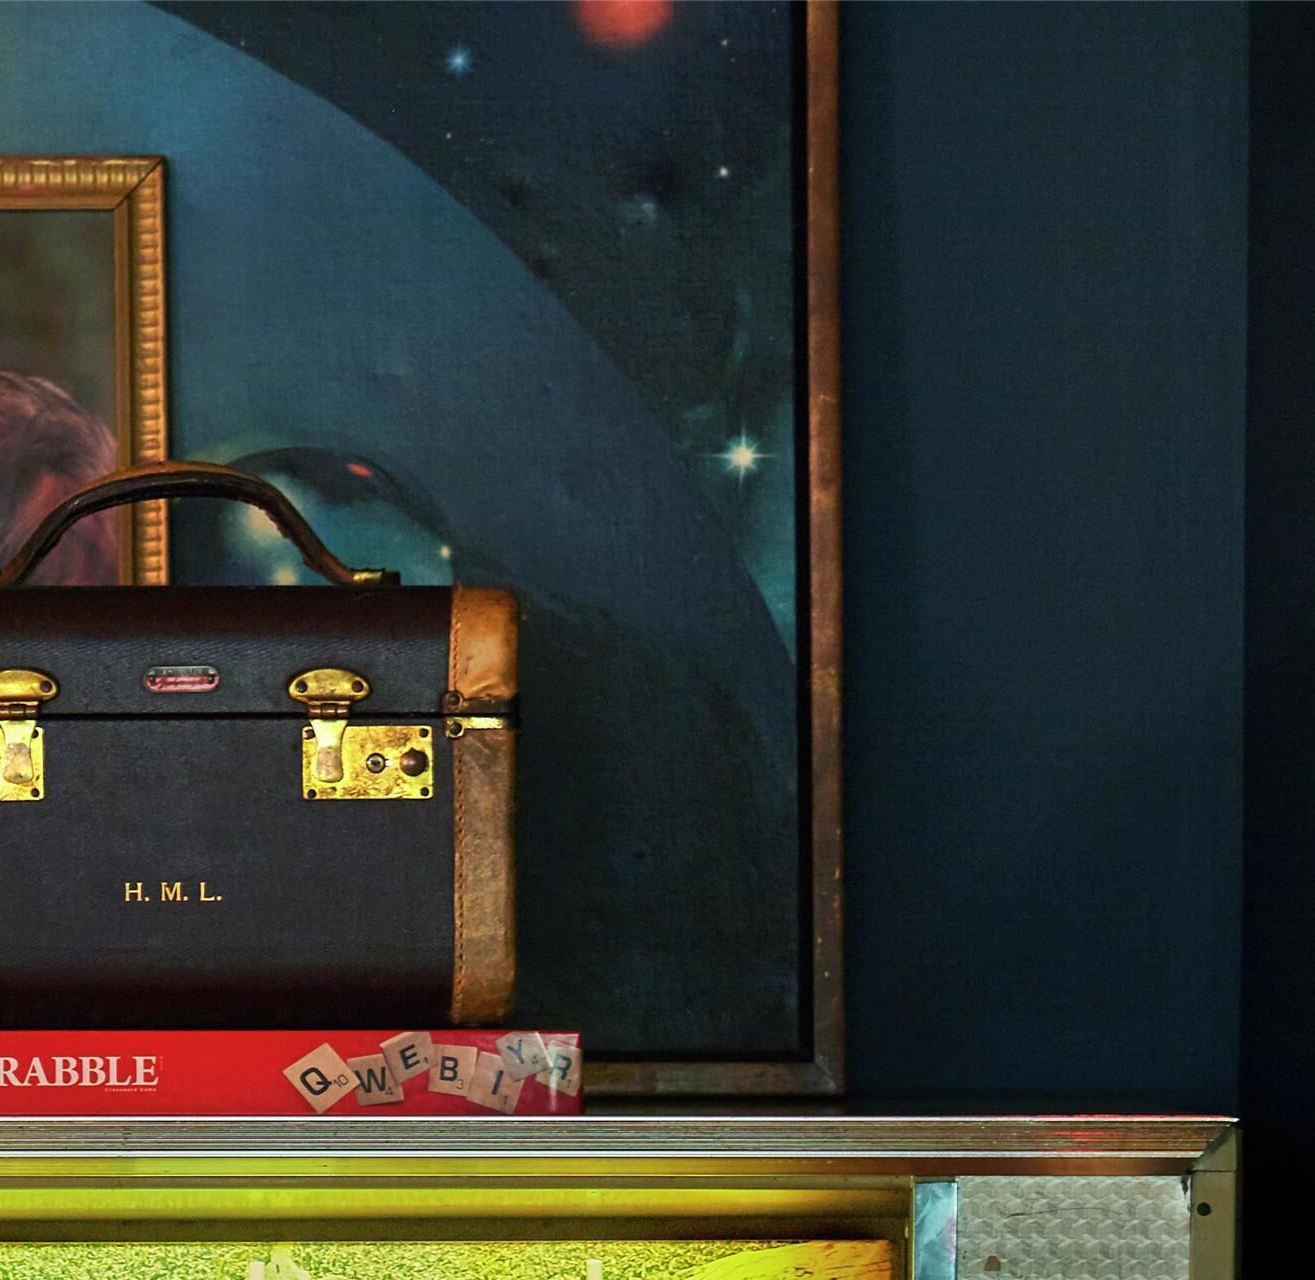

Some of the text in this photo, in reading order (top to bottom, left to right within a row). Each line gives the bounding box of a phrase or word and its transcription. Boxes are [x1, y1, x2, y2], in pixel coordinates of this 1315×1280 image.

[124, 881, 222, 901] H. M. L.
[399, 1044, 420, 1070] E
[439, 1056, 458, 1082] B
[299, 1067, 332, 1096] Q
[356, 1067, 385, 1094] W
